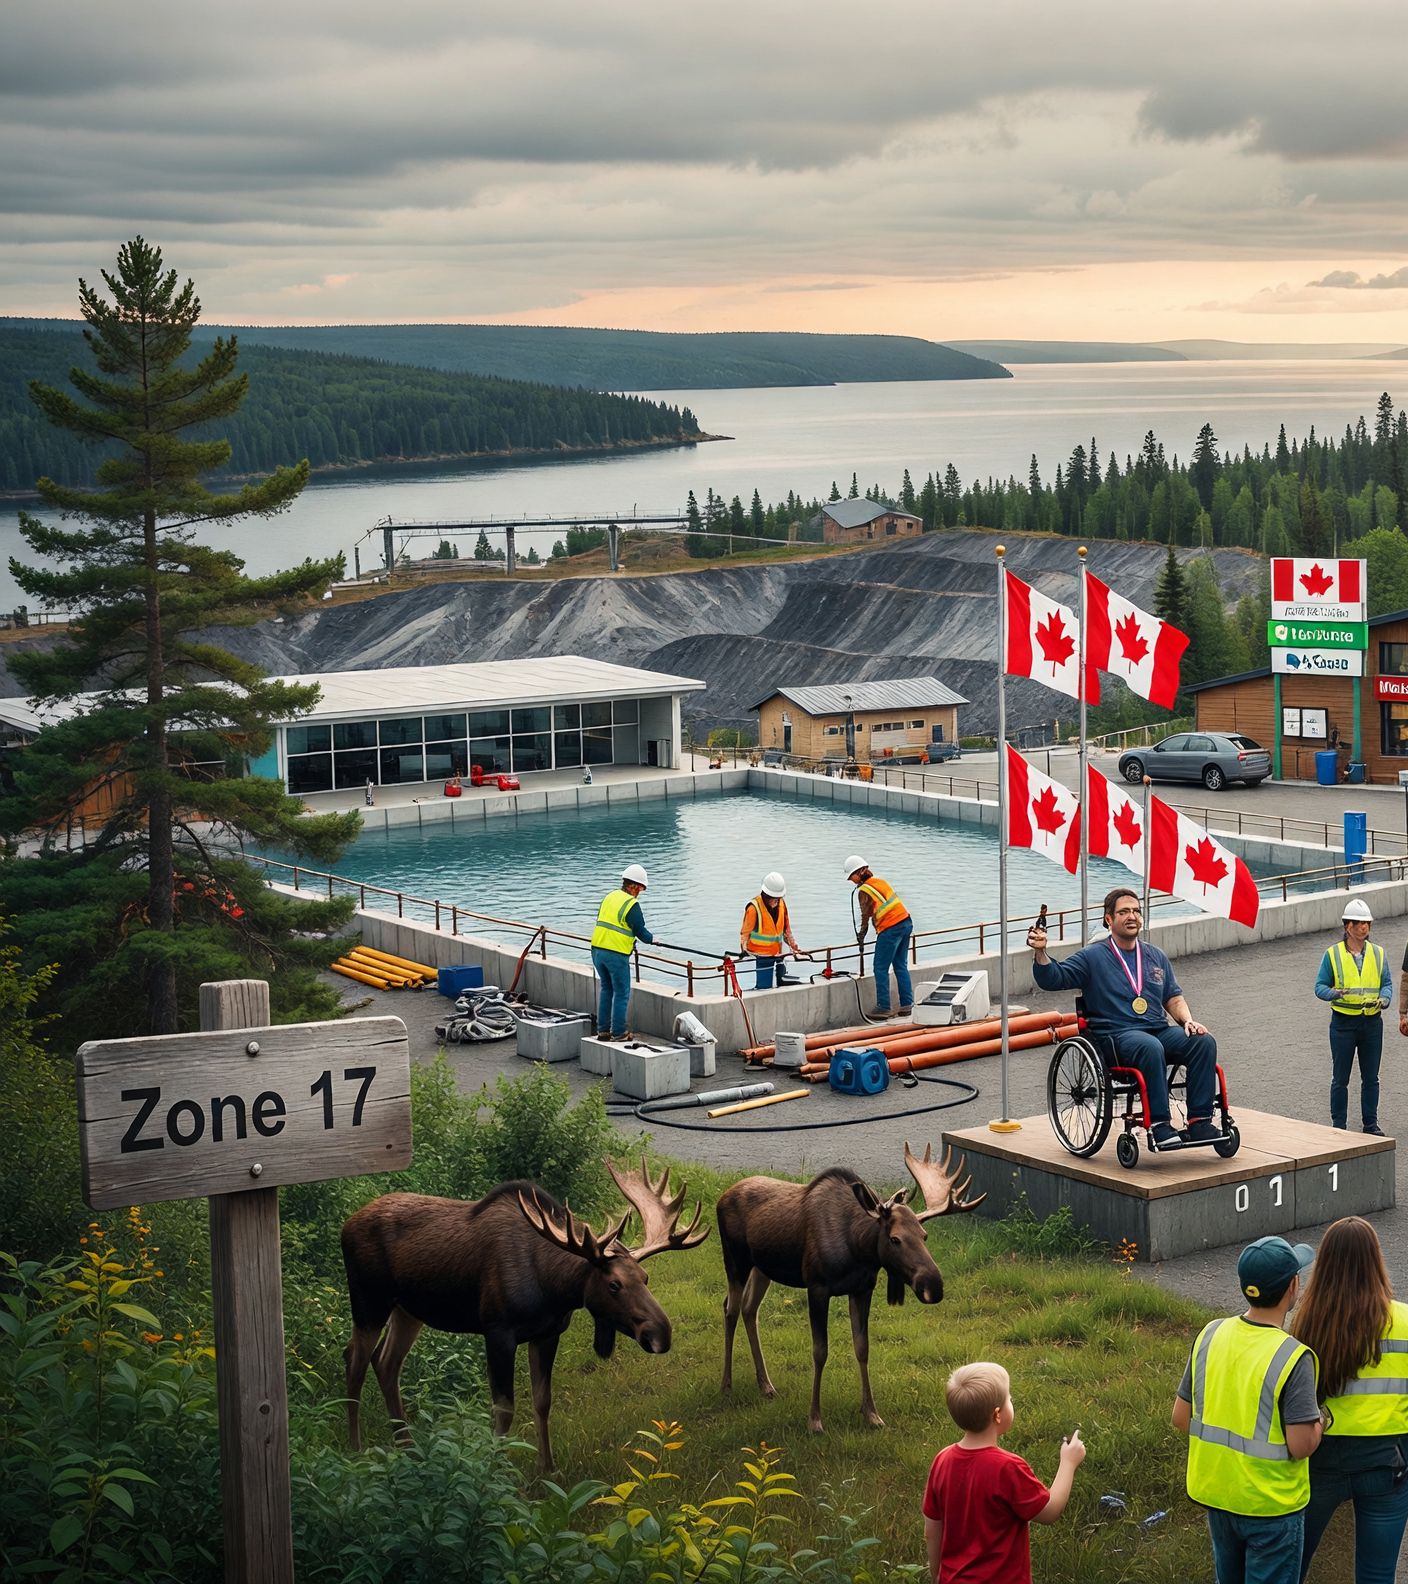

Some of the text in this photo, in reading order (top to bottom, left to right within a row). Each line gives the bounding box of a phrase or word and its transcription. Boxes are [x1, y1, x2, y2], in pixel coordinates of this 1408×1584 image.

[120, 1066, 377, 1154] Zone 17
[1328, 1163, 1338, 1192] 1
